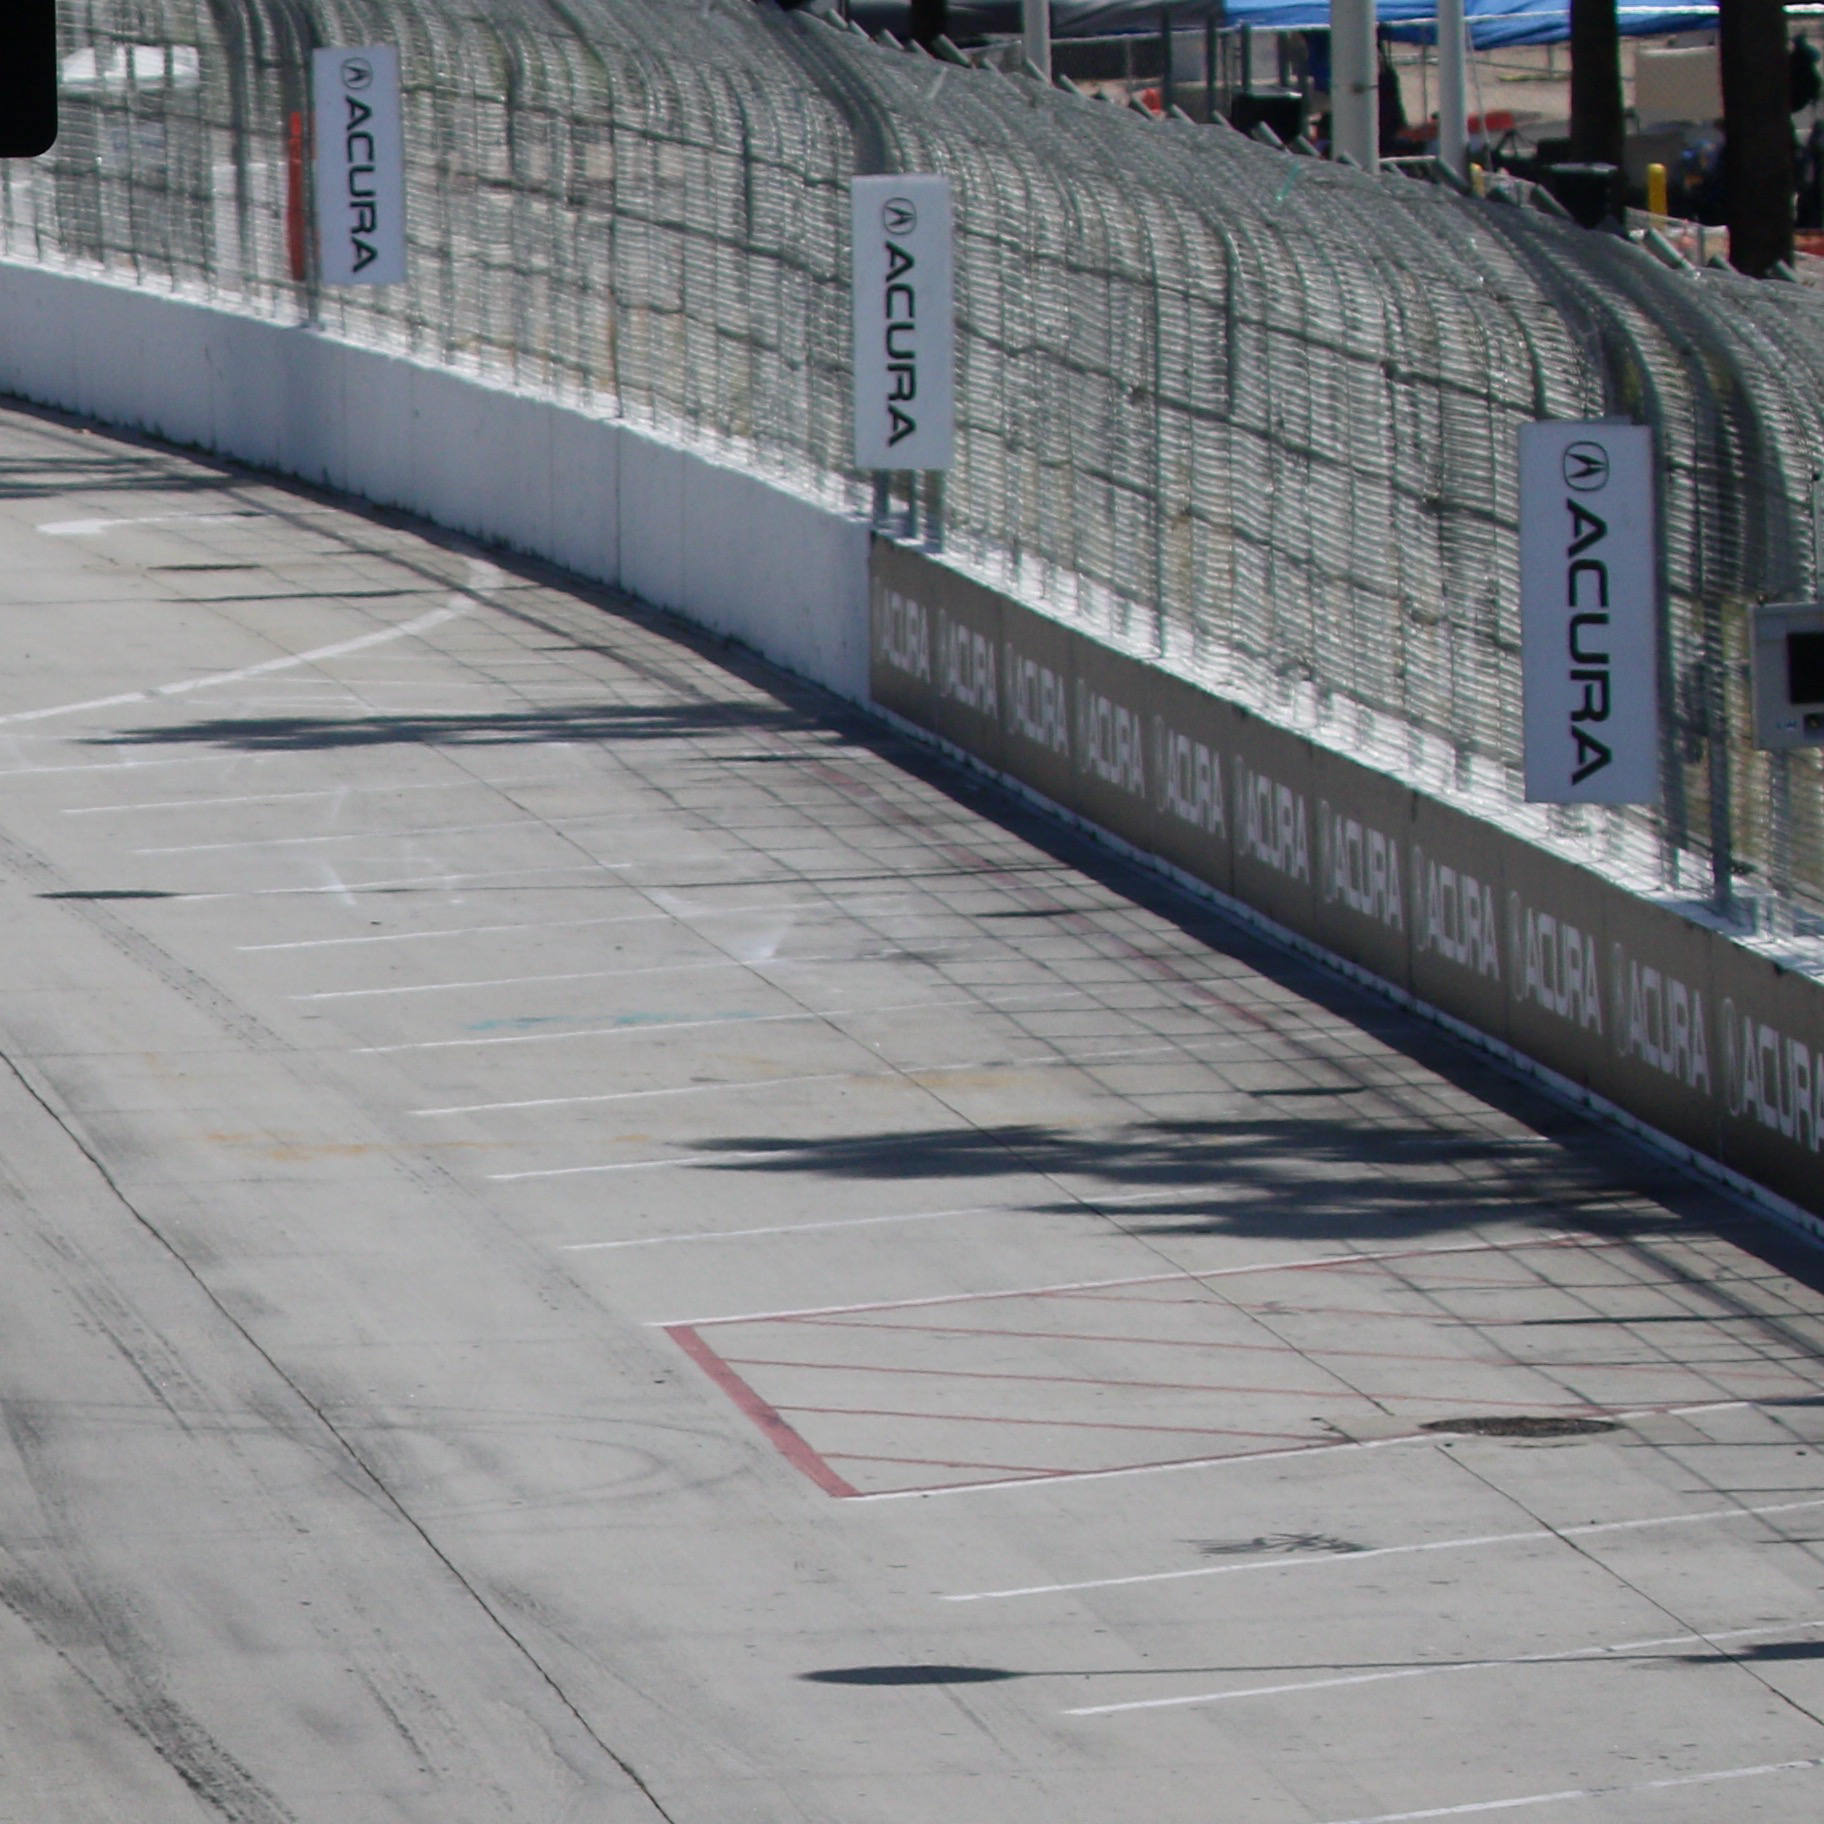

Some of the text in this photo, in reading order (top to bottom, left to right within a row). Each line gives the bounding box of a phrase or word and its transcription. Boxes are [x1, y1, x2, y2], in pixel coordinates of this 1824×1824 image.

[345, 96, 377, 274] ACURA
[884, 241, 917, 447] ACURA
[1566, 498, 1612, 786] ACURA
[1167, 729, 1226, 840] ACURA
[1247, 770, 1309, 884] ACURA
[1333, 815, 1403, 930] ACURA
[1426, 860, 1500, 981] ACURA
[1524, 907, 1603, 1035] ACURA
[1629, 957, 1710, 1094] ACURA
